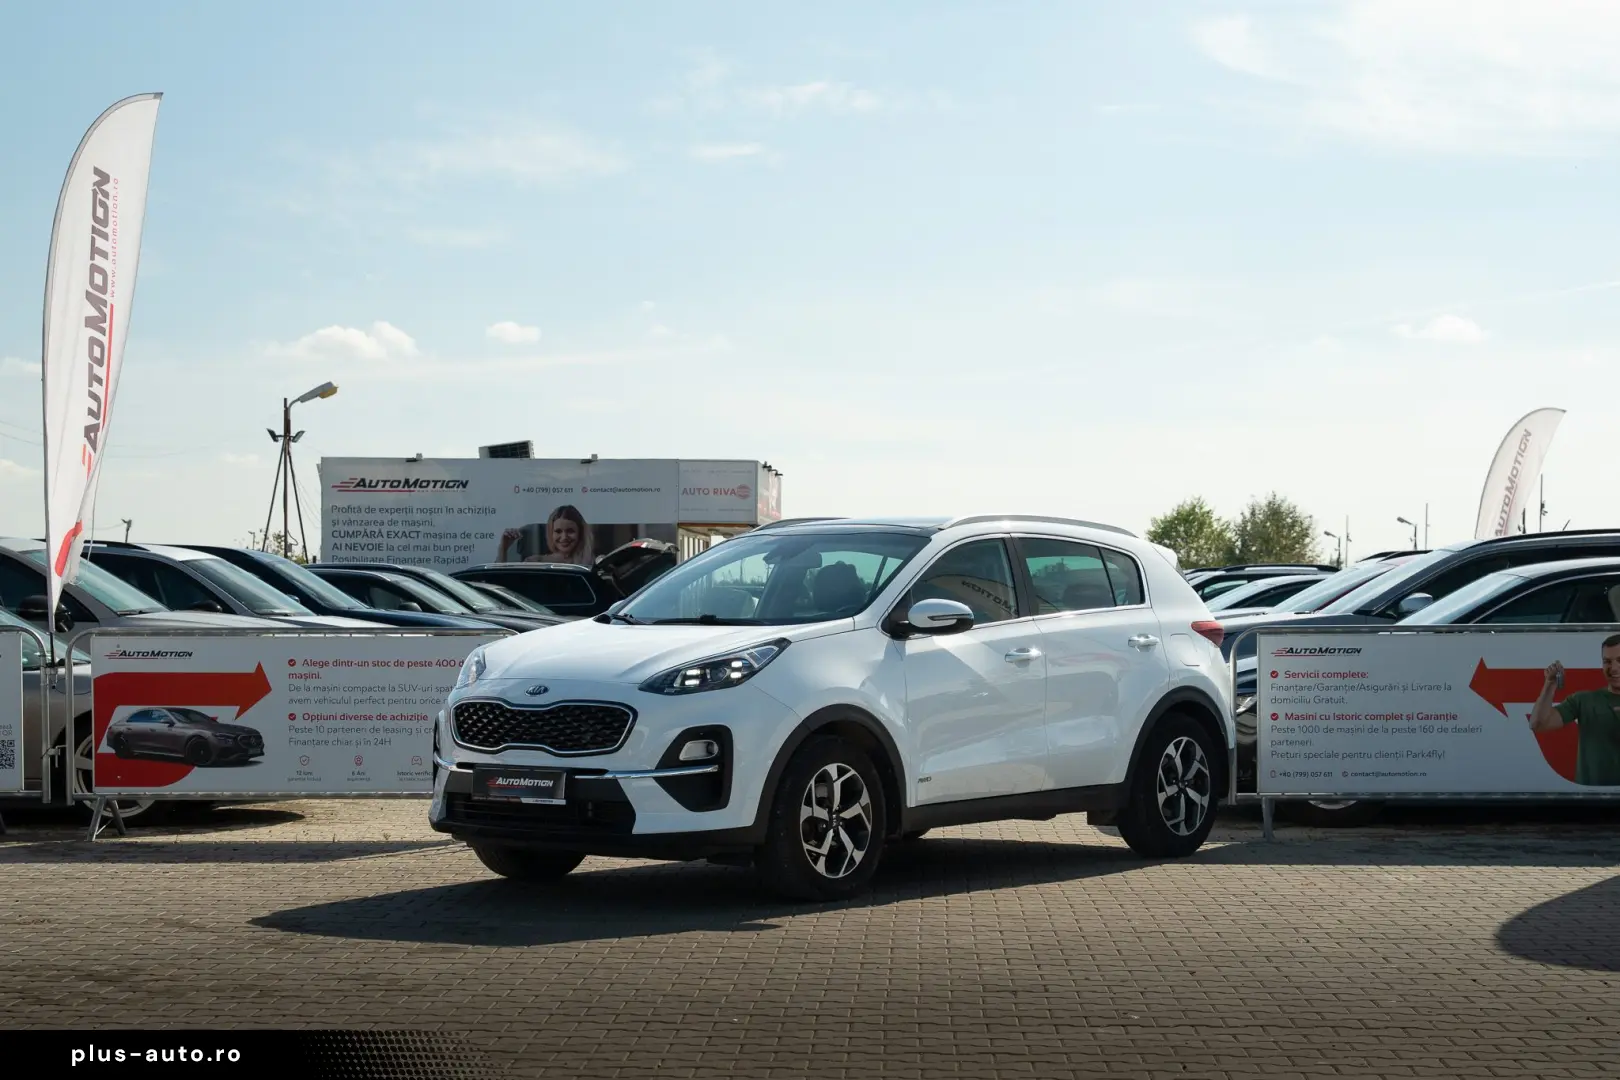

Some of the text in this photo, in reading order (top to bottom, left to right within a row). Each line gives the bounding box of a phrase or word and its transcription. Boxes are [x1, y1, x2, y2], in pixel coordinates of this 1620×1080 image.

[365, 505, 376, 514] de
[387, 530, 420, 539] EXACT
[460, 530, 471, 539] de
[302, 659, 330, 669] Alege
[332, 659, 369, 668] dintr-un
[372, 660, 391, 668] stoc
[393, 659, 405, 668] de
[407, 660, 433, 669] peste
[435, 660, 456, 668] 400
[1284, 670, 1368, 680] Servicii complete:
[288, 684, 301, 692] De
[304, 684, 310, 692] la
[343, 685, 385, 694] compacte
[388, 684, 396, 692] la
[398, 684, 432, 692] SUV-uri
[1411, 683, 1442, 691] Livrare
[1444, 682, 1452, 691] la
[314, 696, 351, 704] vehiculul
[354, 696, 385, 706] perfect
[388, 697, 417, 706] pentru
[420, 696, 441, 704] orice
[1270, 696, 1348, 704] domiciliu Gratuit.
[1333, 712, 1362, 720] Istoric
[1365, 712, 1403, 722] complet
[327, 726, 366, 735] parteneri
[383, 726, 413, 735] leasing
[1271, 725, 1295, 734] Peste
[1298, 725, 1320, 734] 1000
[1323, 725, 1334, 734] de
[1367, 725, 1379, 734] de
[1382, 725, 1388, 734] la
[1392, 726, 1416, 735] peste
[1419, 725, 1434, 734] 160
[1437, 725, 1448, 734] de
[1451, 725, 1482, 734] dealeri
[1304, 750, 1339, 760] speciale
[1342, 751, 1371, 760] pentru
[1406, 750, 1445, 760] Park4fly!
